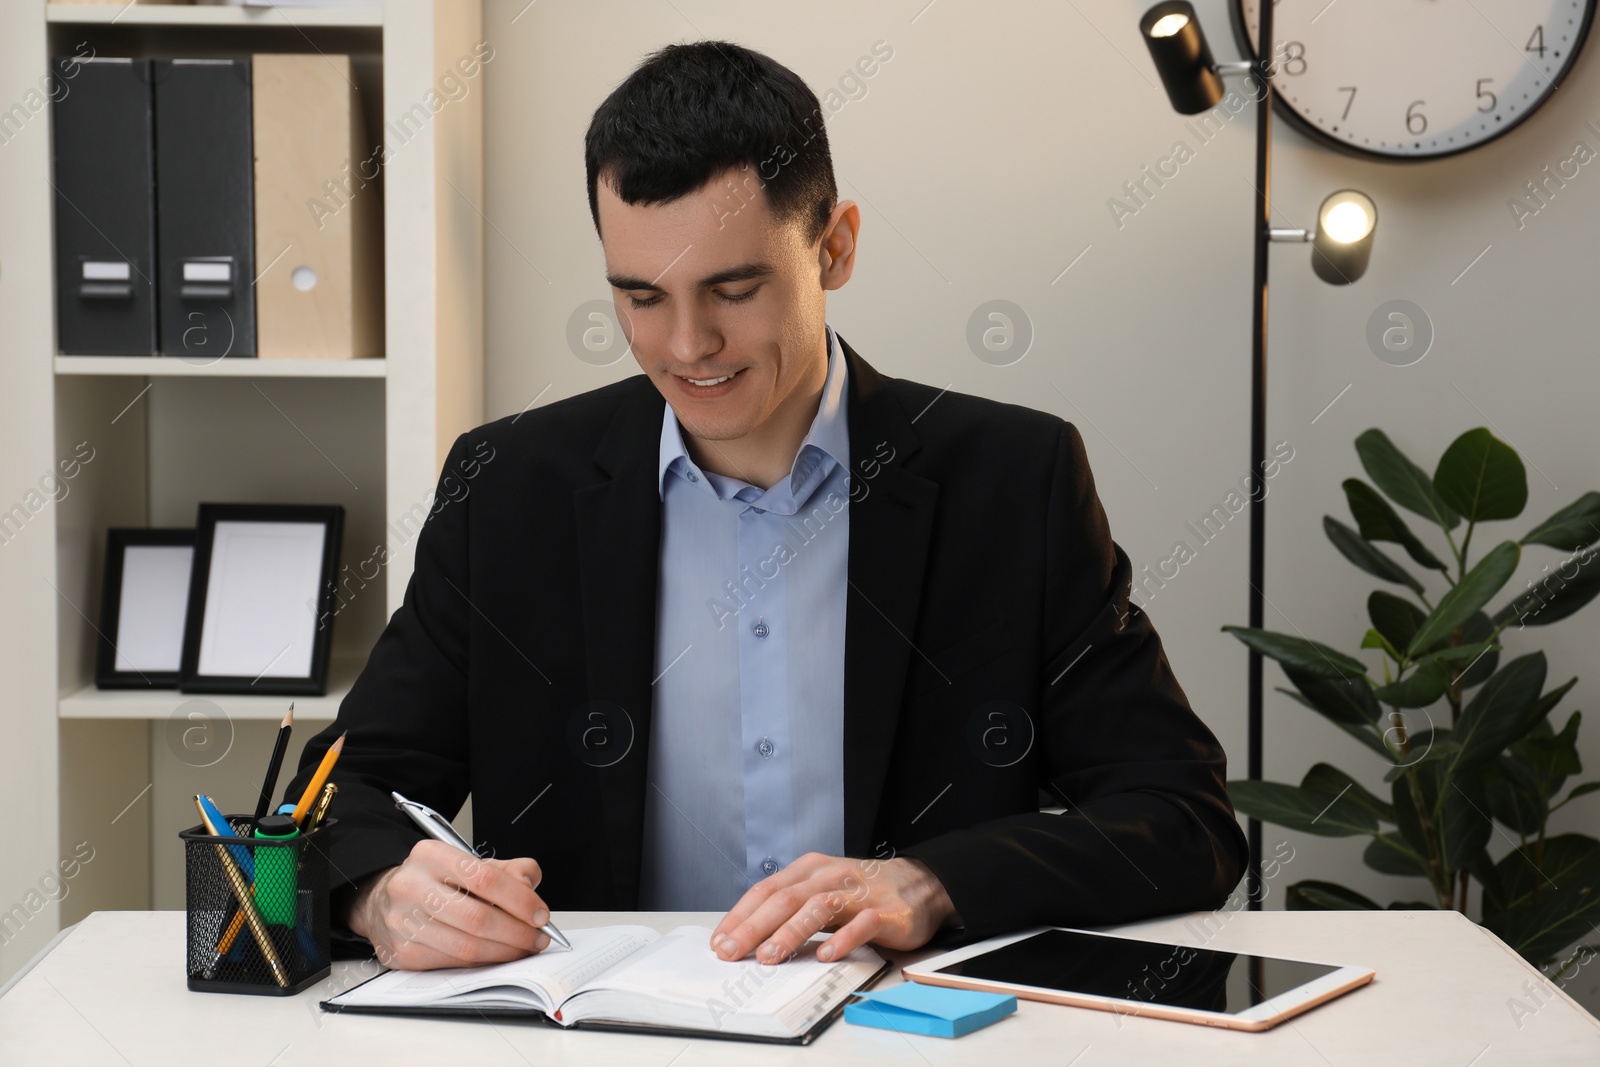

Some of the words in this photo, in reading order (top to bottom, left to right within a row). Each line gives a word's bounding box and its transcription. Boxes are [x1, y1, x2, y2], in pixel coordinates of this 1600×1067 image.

[1283, 41, 1307, 76] 8
[1525, 24, 1548, 58] 4
[1338, 86, 1357, 121] 7
[1476, 78, 1497, 113] 5
[1406, 100, 1427, 136] 6
